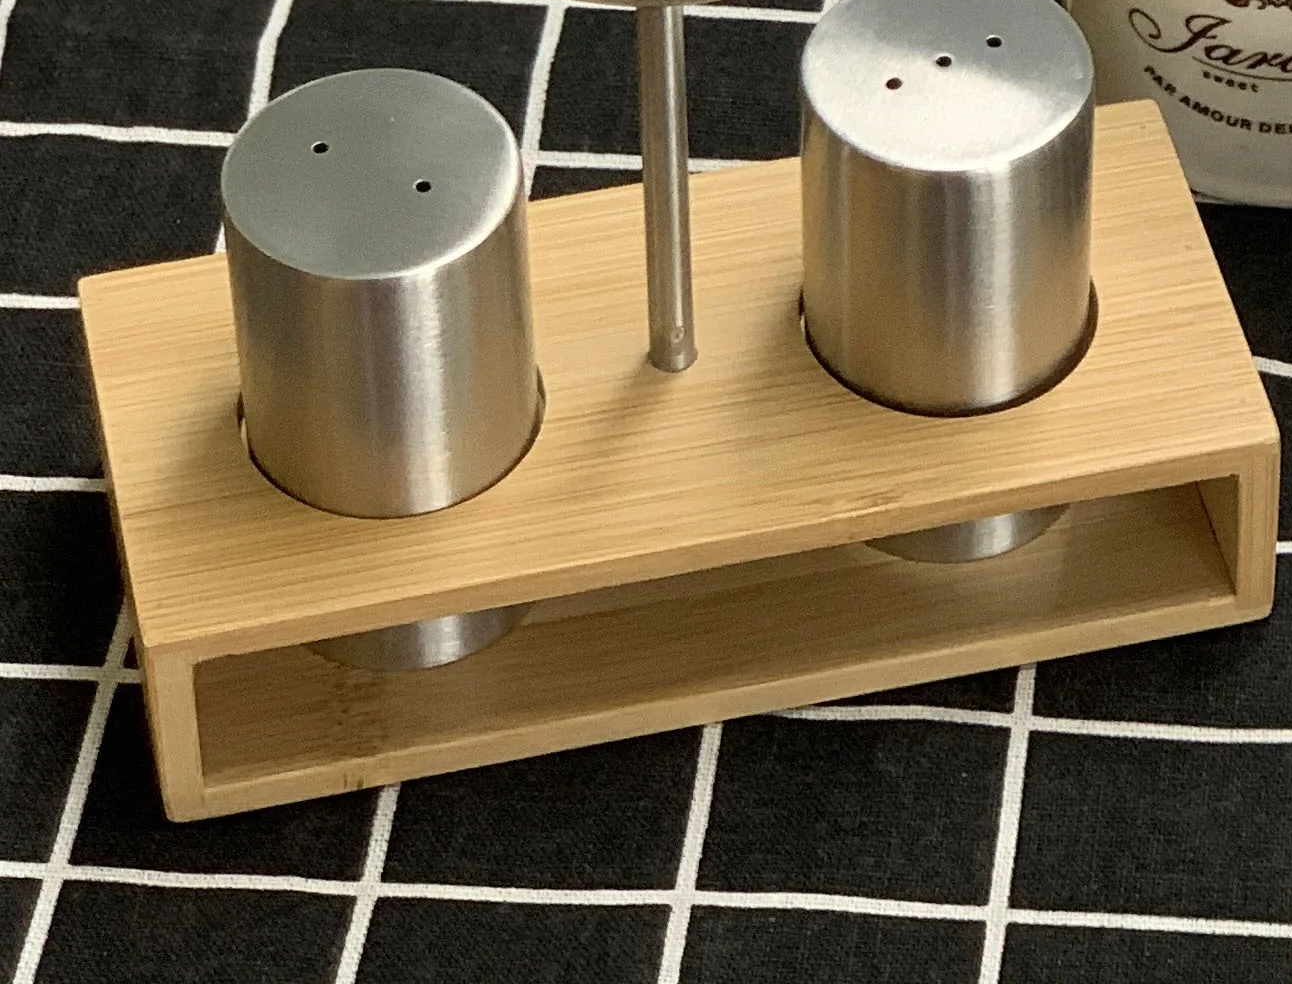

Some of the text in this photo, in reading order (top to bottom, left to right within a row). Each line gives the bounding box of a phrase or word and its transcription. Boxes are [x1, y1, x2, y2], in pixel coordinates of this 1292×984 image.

[1144, 65, 1177, 96] PAR
[1179, 95, 1252, 131] AMOUR
[1203, 70, 1259, 93] sweet
